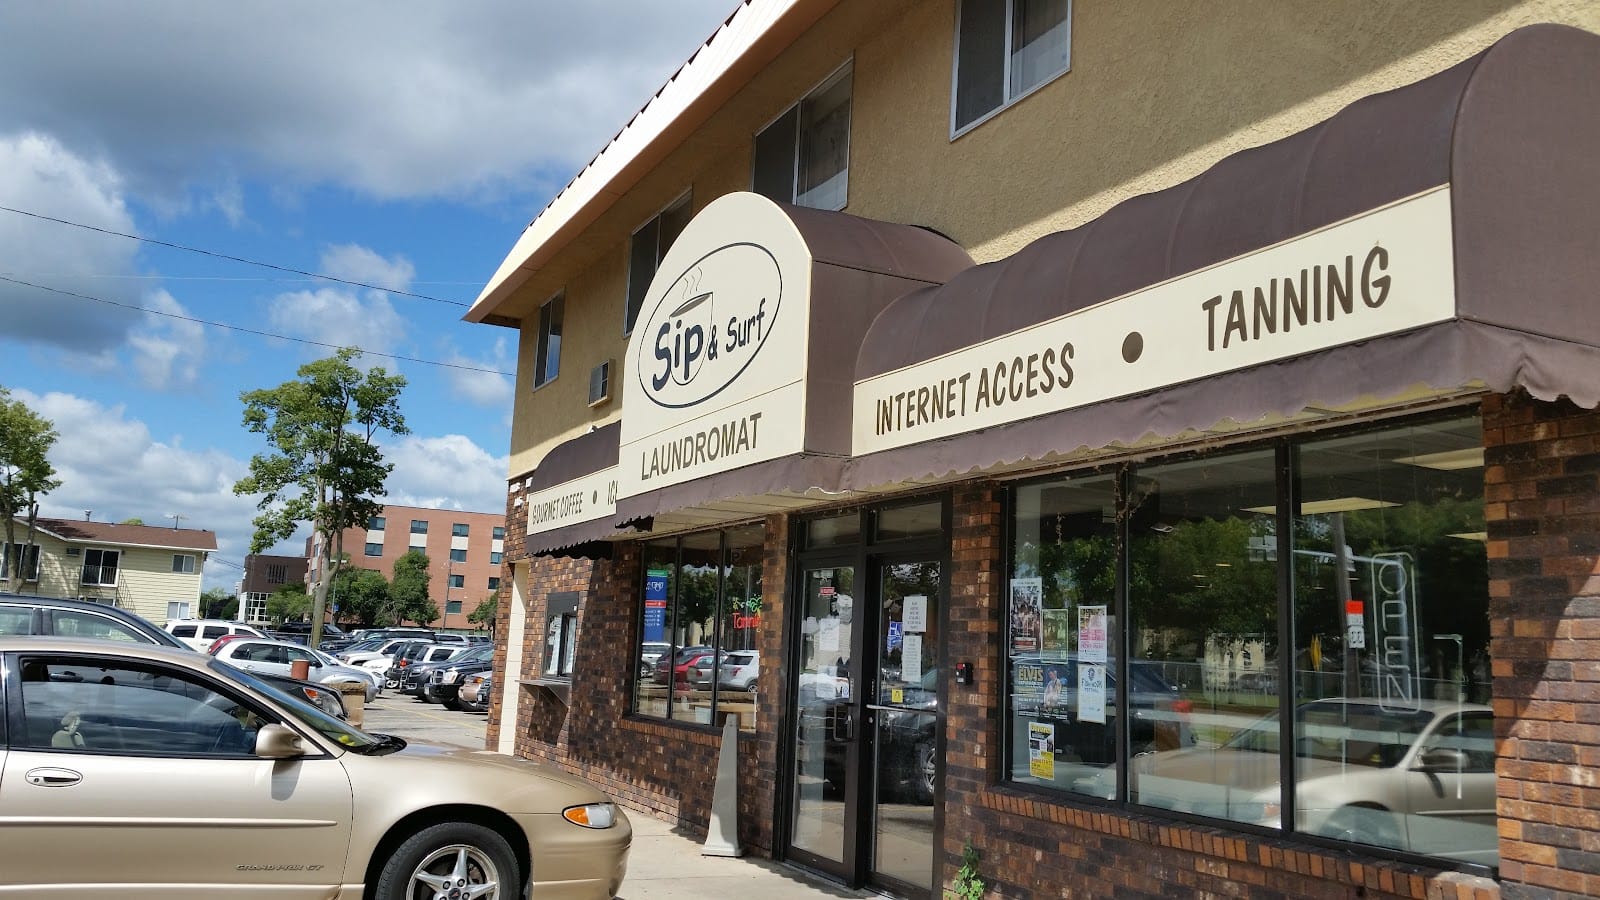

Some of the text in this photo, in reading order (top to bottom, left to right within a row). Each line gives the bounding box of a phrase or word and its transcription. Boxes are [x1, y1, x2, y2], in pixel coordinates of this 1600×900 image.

[1202, 246, 1391, 351] TANNING
[652, 297, 766, 392] Sip & Surf
[876, 342, 1075, 436] INTERNET ACCESS
[641, 411, 762, 481] LAUNDROMAT
[532, 491, 584, 525] GOURMET COFFEE
[1018, 667, 1044, 682] ELVIS
